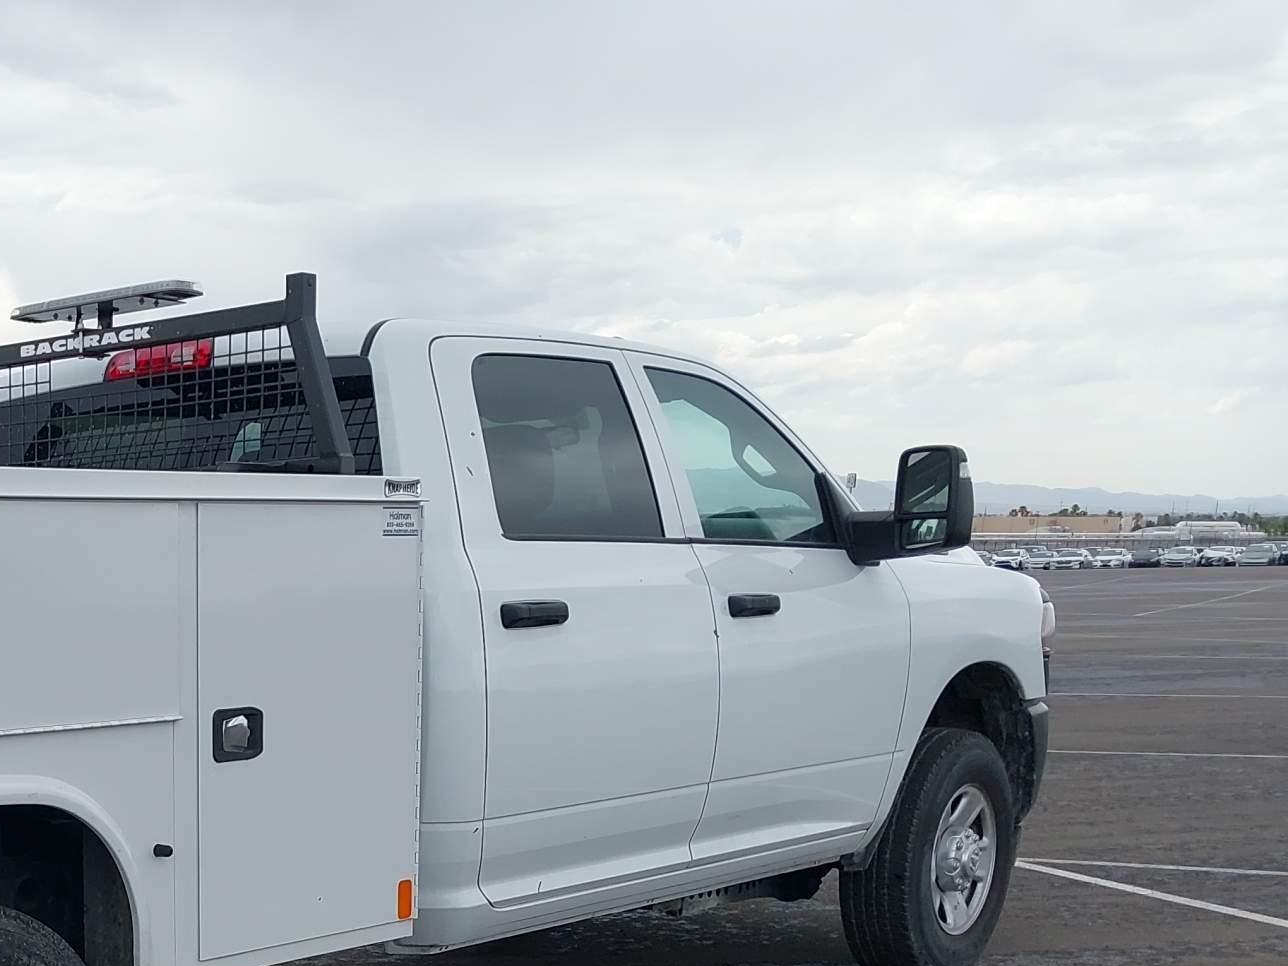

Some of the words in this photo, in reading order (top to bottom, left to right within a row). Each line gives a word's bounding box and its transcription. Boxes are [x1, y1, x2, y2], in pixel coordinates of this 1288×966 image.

[20, 326, 151, 358] BACKRACK
[387, 481, 419, 494] KNAPHEIDE
[388, 511, 412, 520] Holman
